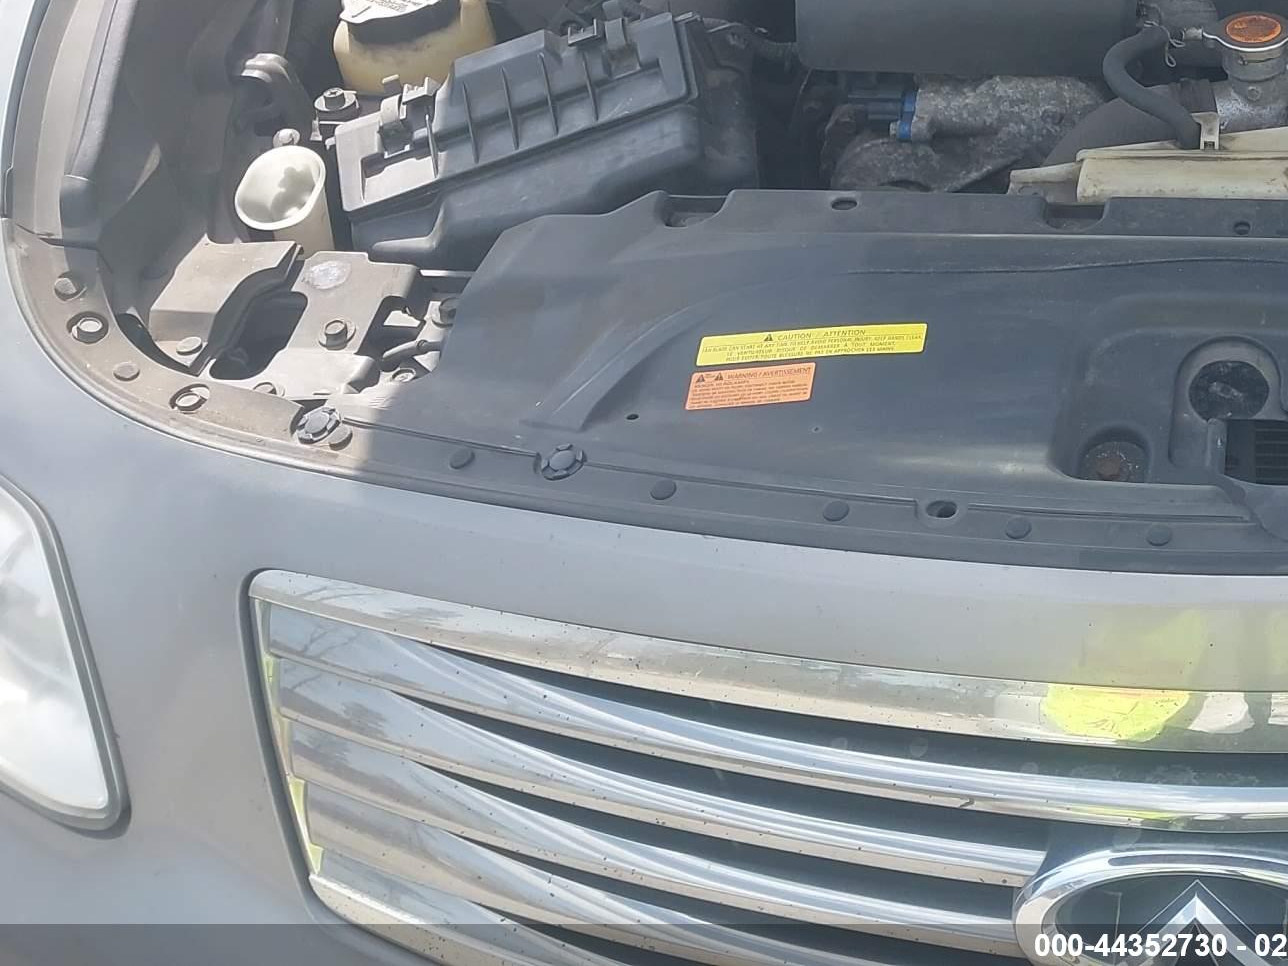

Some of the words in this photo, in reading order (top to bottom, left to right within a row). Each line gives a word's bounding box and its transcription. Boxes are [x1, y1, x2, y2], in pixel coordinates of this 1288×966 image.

[777, 332, 812, 341] CAUTION
[823, 329, 866, 338] ATTENTION
[728, 370, 758, 380] WARNING
[762, 366, 811, 377] AVERTISSEMENT
